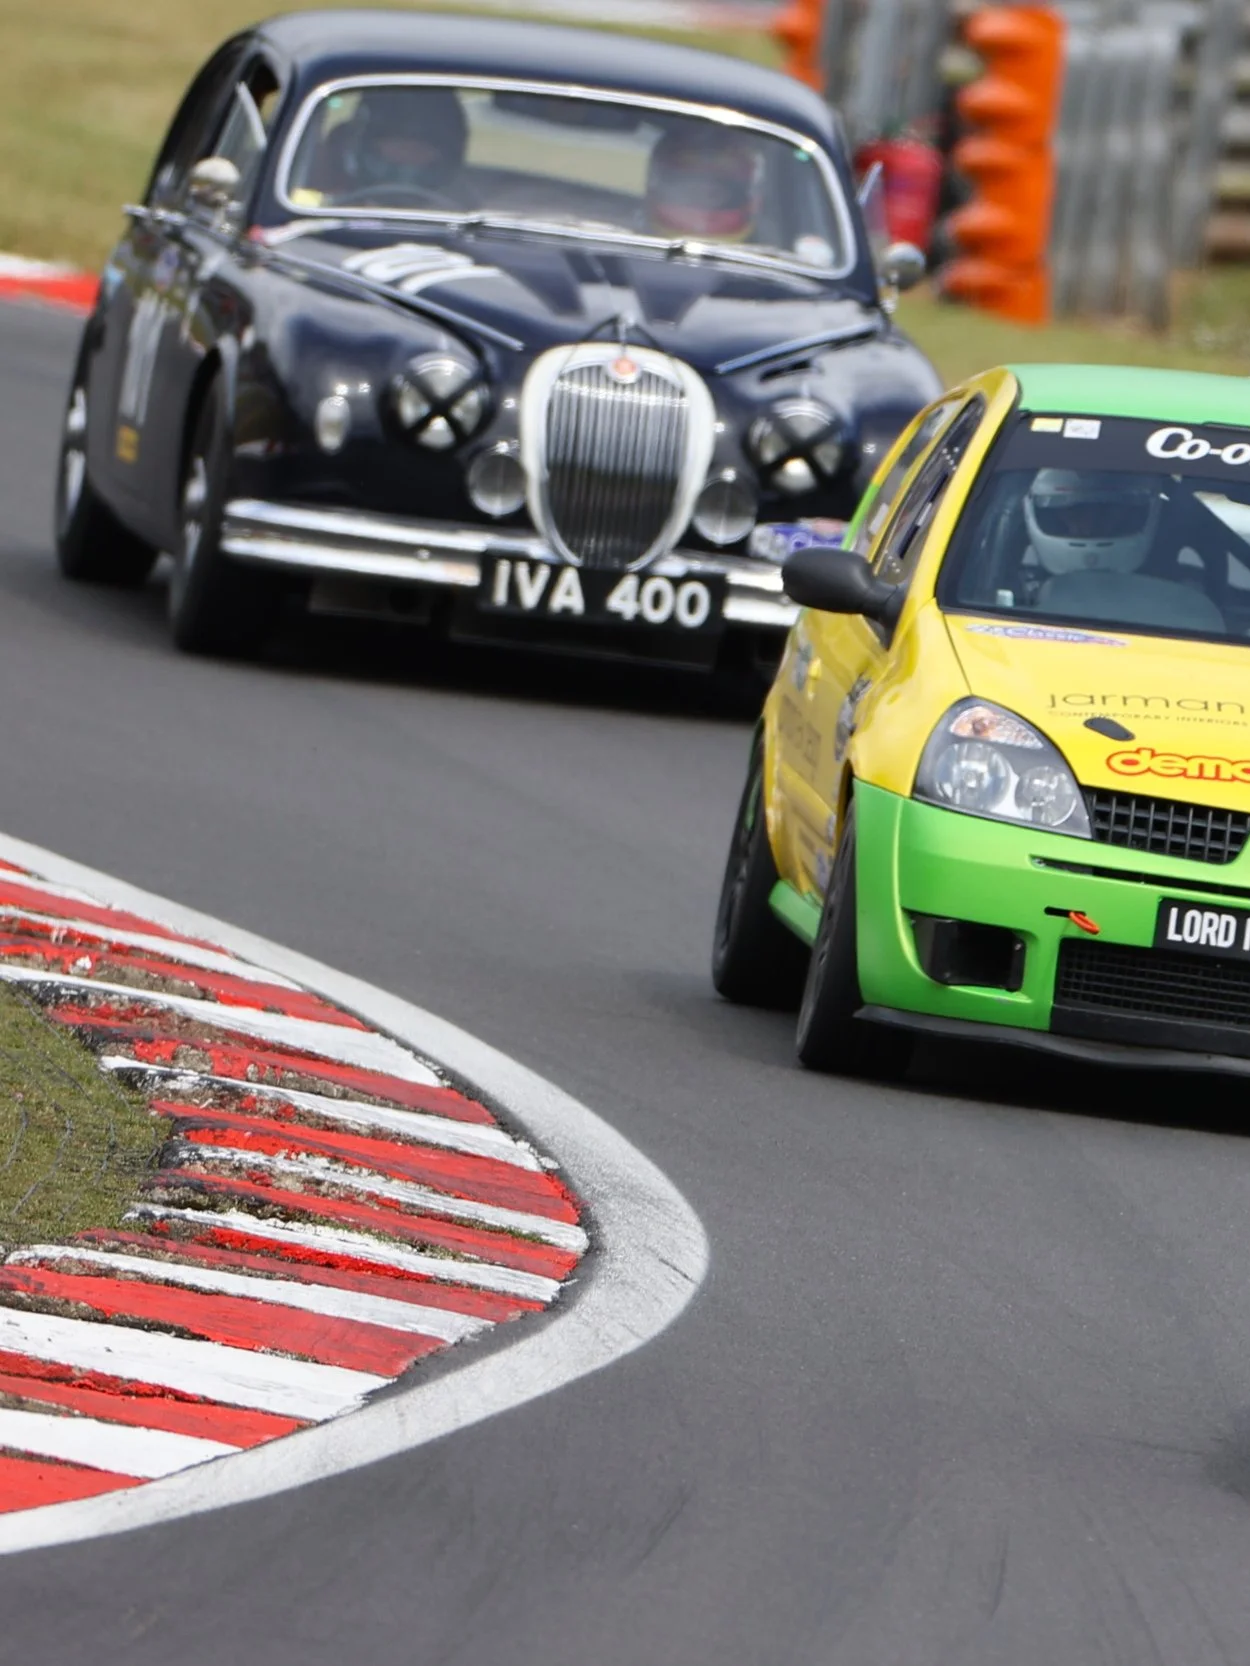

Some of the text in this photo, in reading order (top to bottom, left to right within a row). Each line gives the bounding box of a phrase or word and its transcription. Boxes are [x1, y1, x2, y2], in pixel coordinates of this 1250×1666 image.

[492, 559, 711, 628] IVA 400
[1048, 709, 1249, 727] CONTEMPORARY INTERIORS
[1049, 693, 1245, 715] jarman
[1167, 907, 1237, 948] LORD
